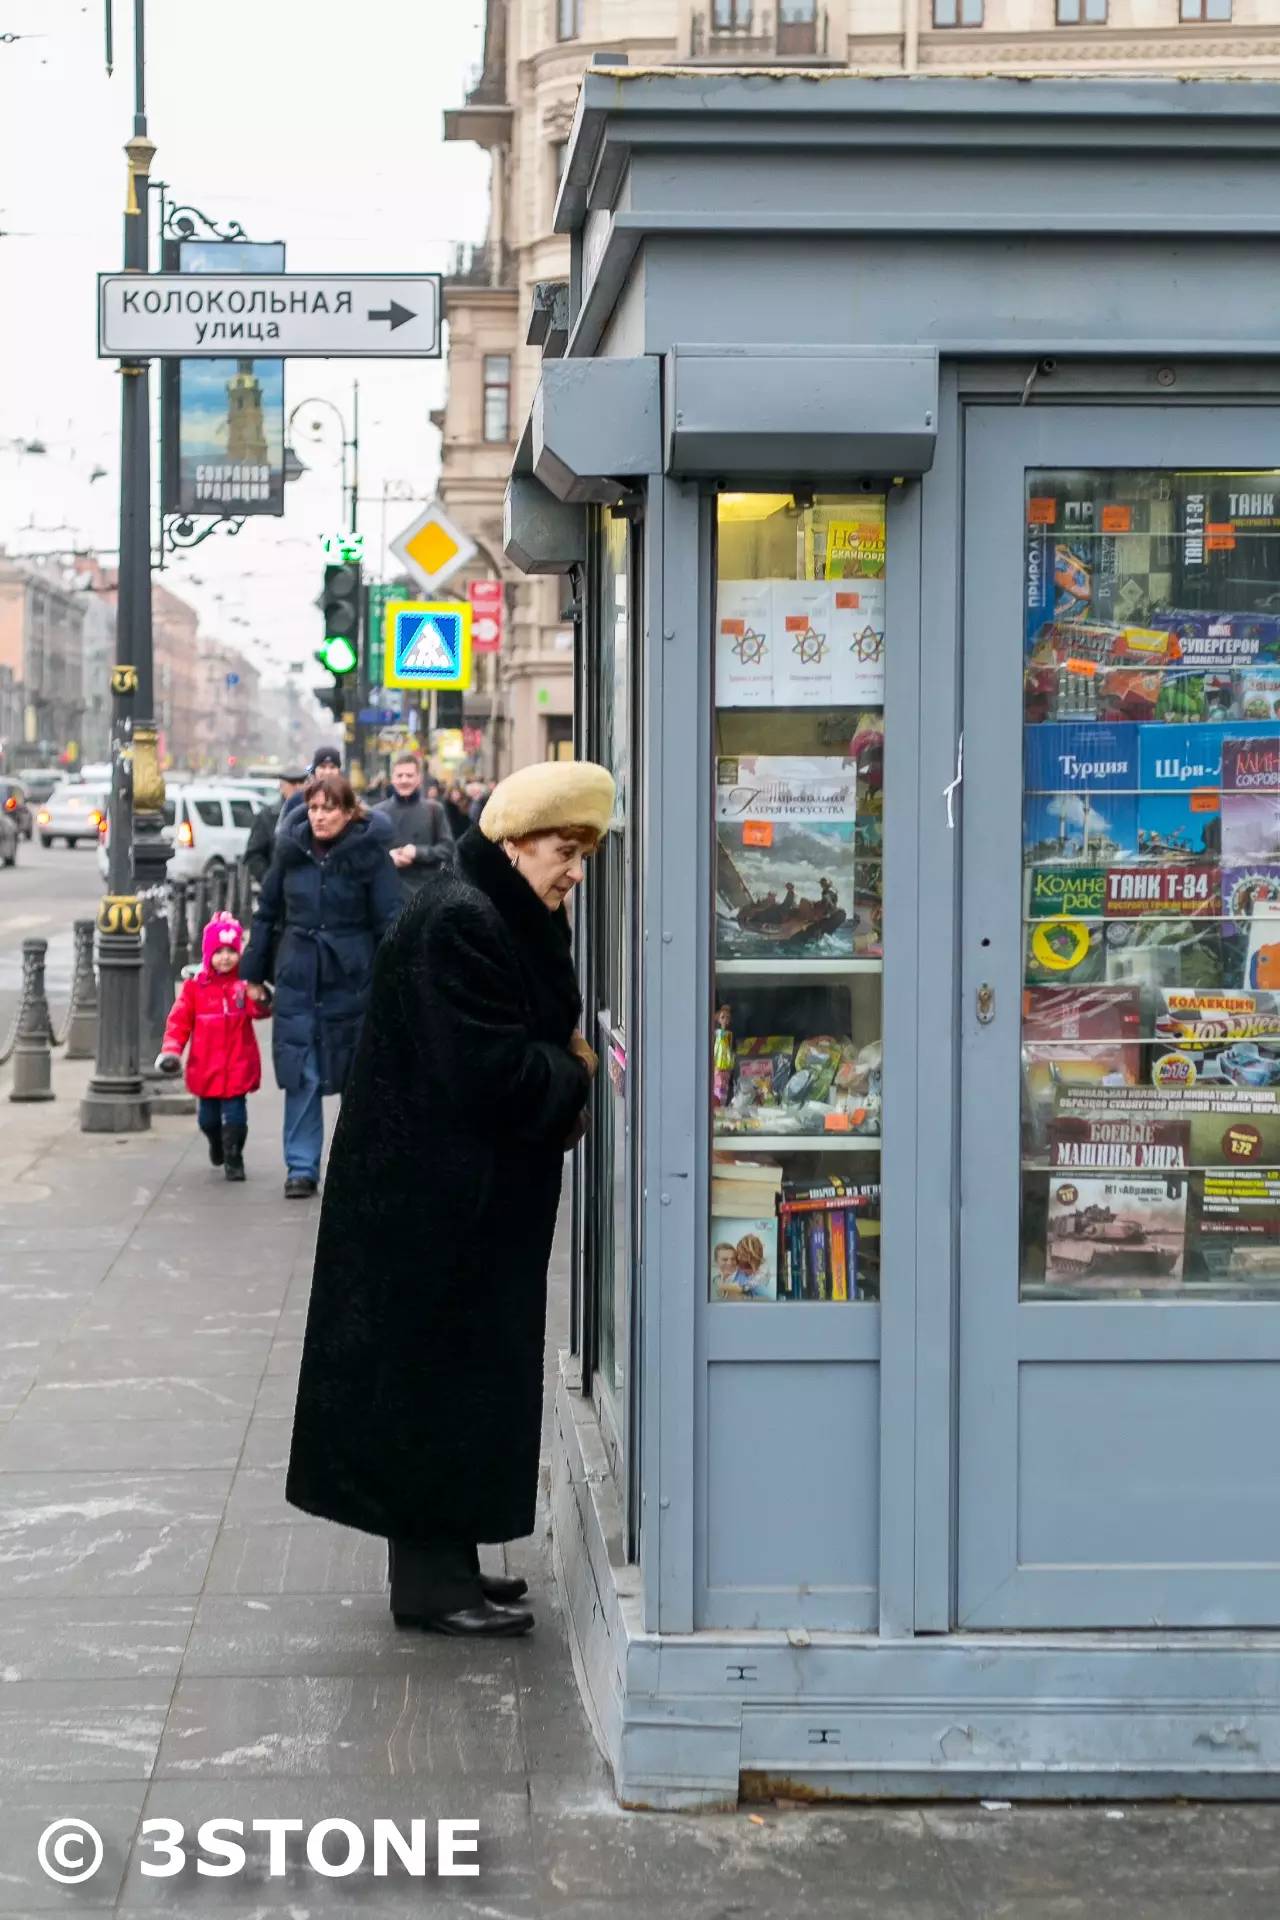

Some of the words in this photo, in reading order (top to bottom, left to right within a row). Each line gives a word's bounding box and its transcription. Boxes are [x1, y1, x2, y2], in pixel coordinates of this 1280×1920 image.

[122, 290, 353, 314] КОЛОКОЛЬНАЯ
[195, 321, 281, 344] улица
[1185, 494, 1205, 526] Т-34
[1228, 493, 1275, 516] ТАНК
[1184, 528, 1204, 566] ТАНК
[1179, 637, 1260, 654] СУПЕРГЕРОИ
[1058, 755, 1128, 779] Турция
[1109, 874, 1161, 899] ТАНК
[1167, 874, 1209, 899] Т-34
[1062, 893, 1104, 914] рас
[1090, 1122, 1155, 1143] БОЕВЫЕ
[1057, 1142, 1137, 1168] МАШИНЫ
[1140, 1144, 1185, 1169] МИРА
